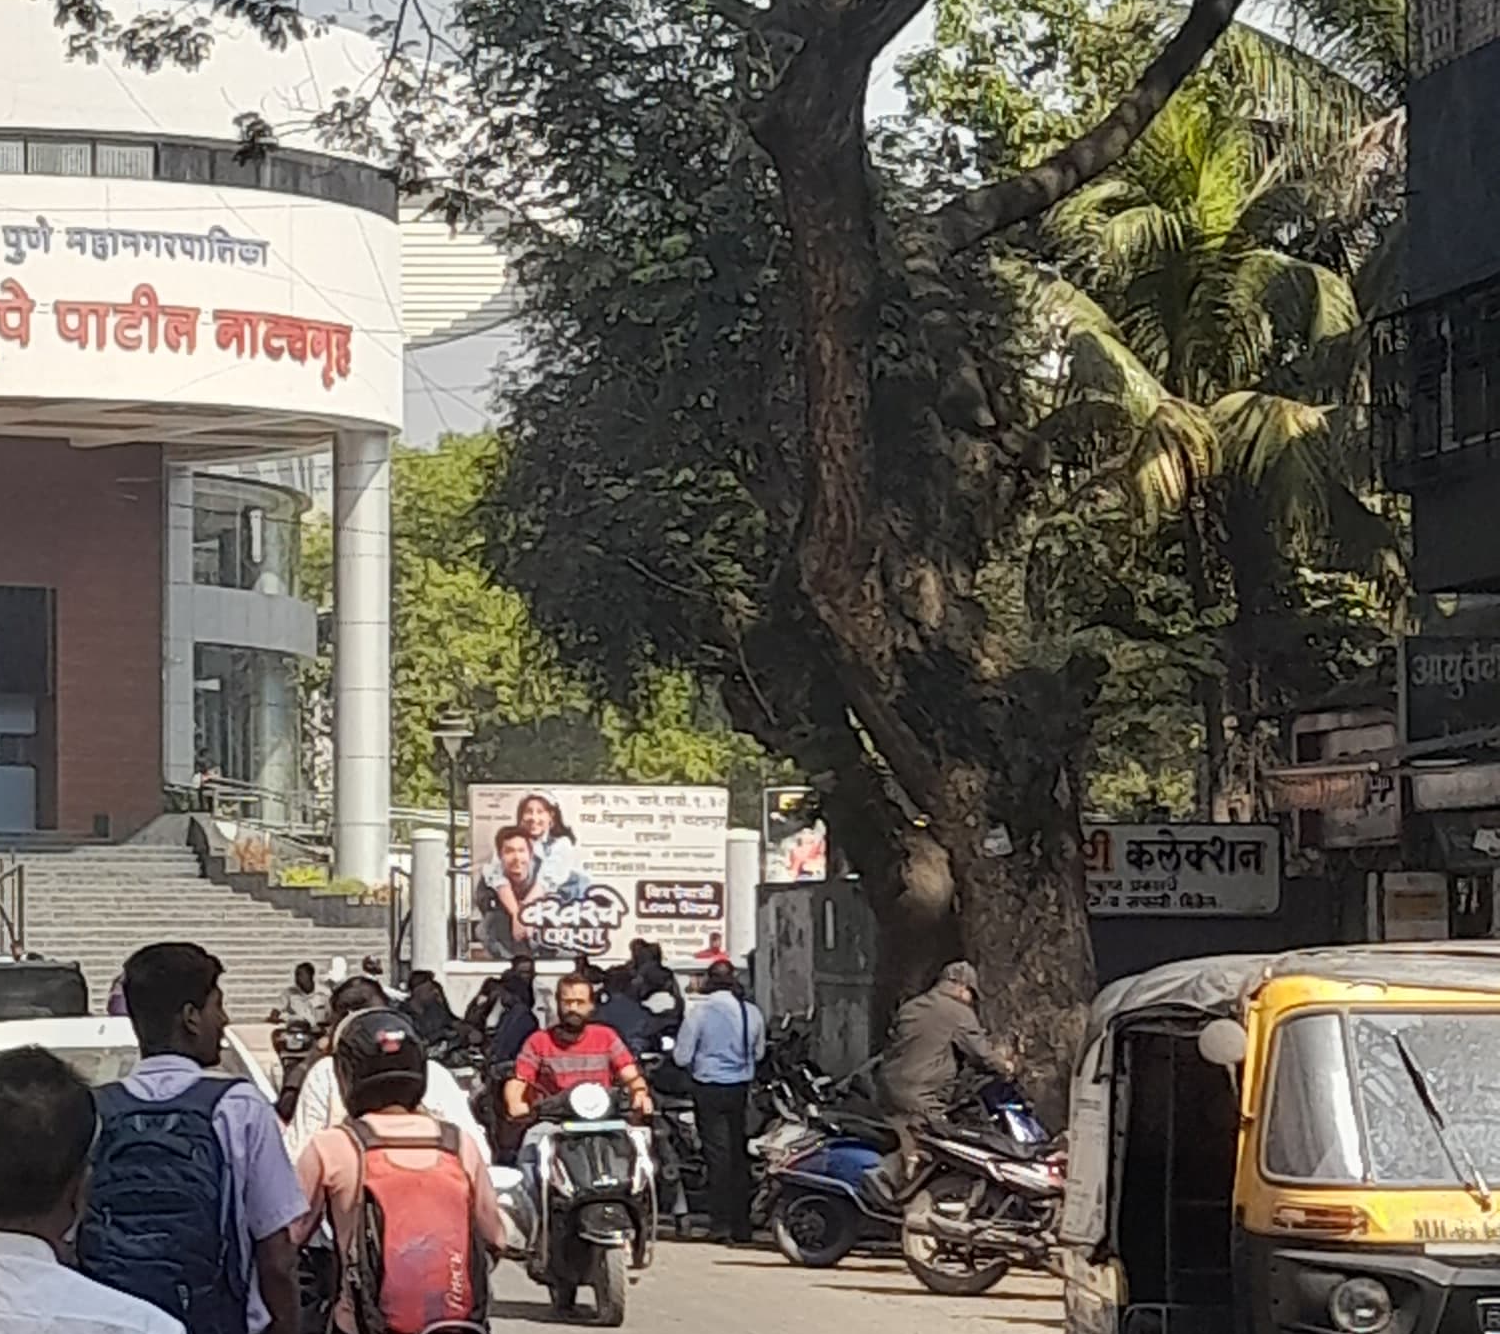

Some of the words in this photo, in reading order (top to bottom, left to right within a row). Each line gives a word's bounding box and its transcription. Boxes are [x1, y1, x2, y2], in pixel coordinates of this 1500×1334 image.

[2, 215, 54, 265] पुणे
[53, 282, 201, 356] पाटील
[1125, 828, 1268, 875] कलेक्शन
